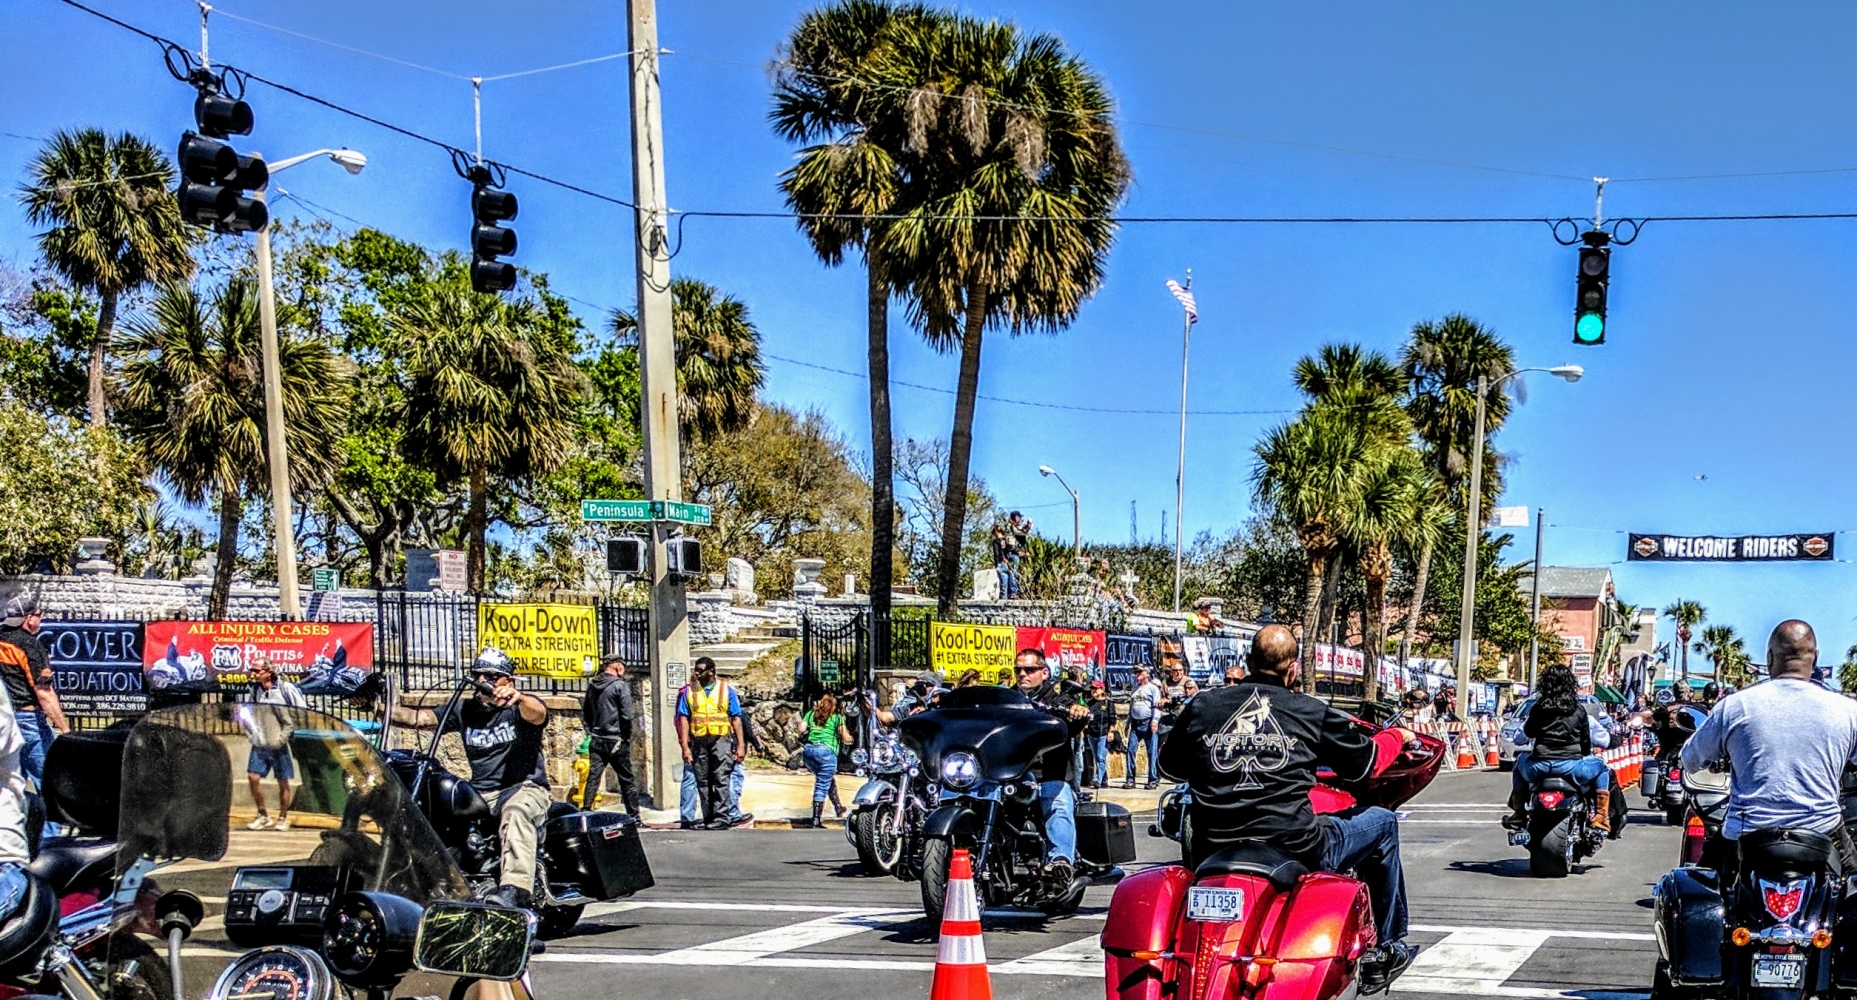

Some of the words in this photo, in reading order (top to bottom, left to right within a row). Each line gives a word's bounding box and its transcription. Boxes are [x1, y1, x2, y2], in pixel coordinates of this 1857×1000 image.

[589, 503, 645, 518] Peninsula
[669, 503, 689, 520] Main
[1663, 537, 1736, 558] WELCOME
[1743, 537, 1799, 558] RIDERS
[485, 608, 592, 635] Kool-Down
[188, 625, 217, 635] ALL
[220, 625, 277, 636] INJURY
[280, 625, 330, 636] CASES
[485, 636, 496, 648] #1
[499, 637, 532, 651] EXTRA
[536, 637, 593, 652] STRENGTH
[936, 627, 1012, 651] Kool-Down
[243, 644, 297, 660] POLITIS
[936, 651, 945, 664] #1
[947, 651, 973, 665] EXTRA
[974, 653, 1013, 666] STRENGTH
[510, 656, 529, 671] RN
[532, 657, 577, 672] RELIEVE
[980, 670, 1001, 683] ELIEV
[96, 702, 146, 711] 386.226.9810
[1202, 733, 1299, 749] VICTORY
[1205, 895, 1237, 909] 11358
[1768, 963, 1799, 977] 90776
